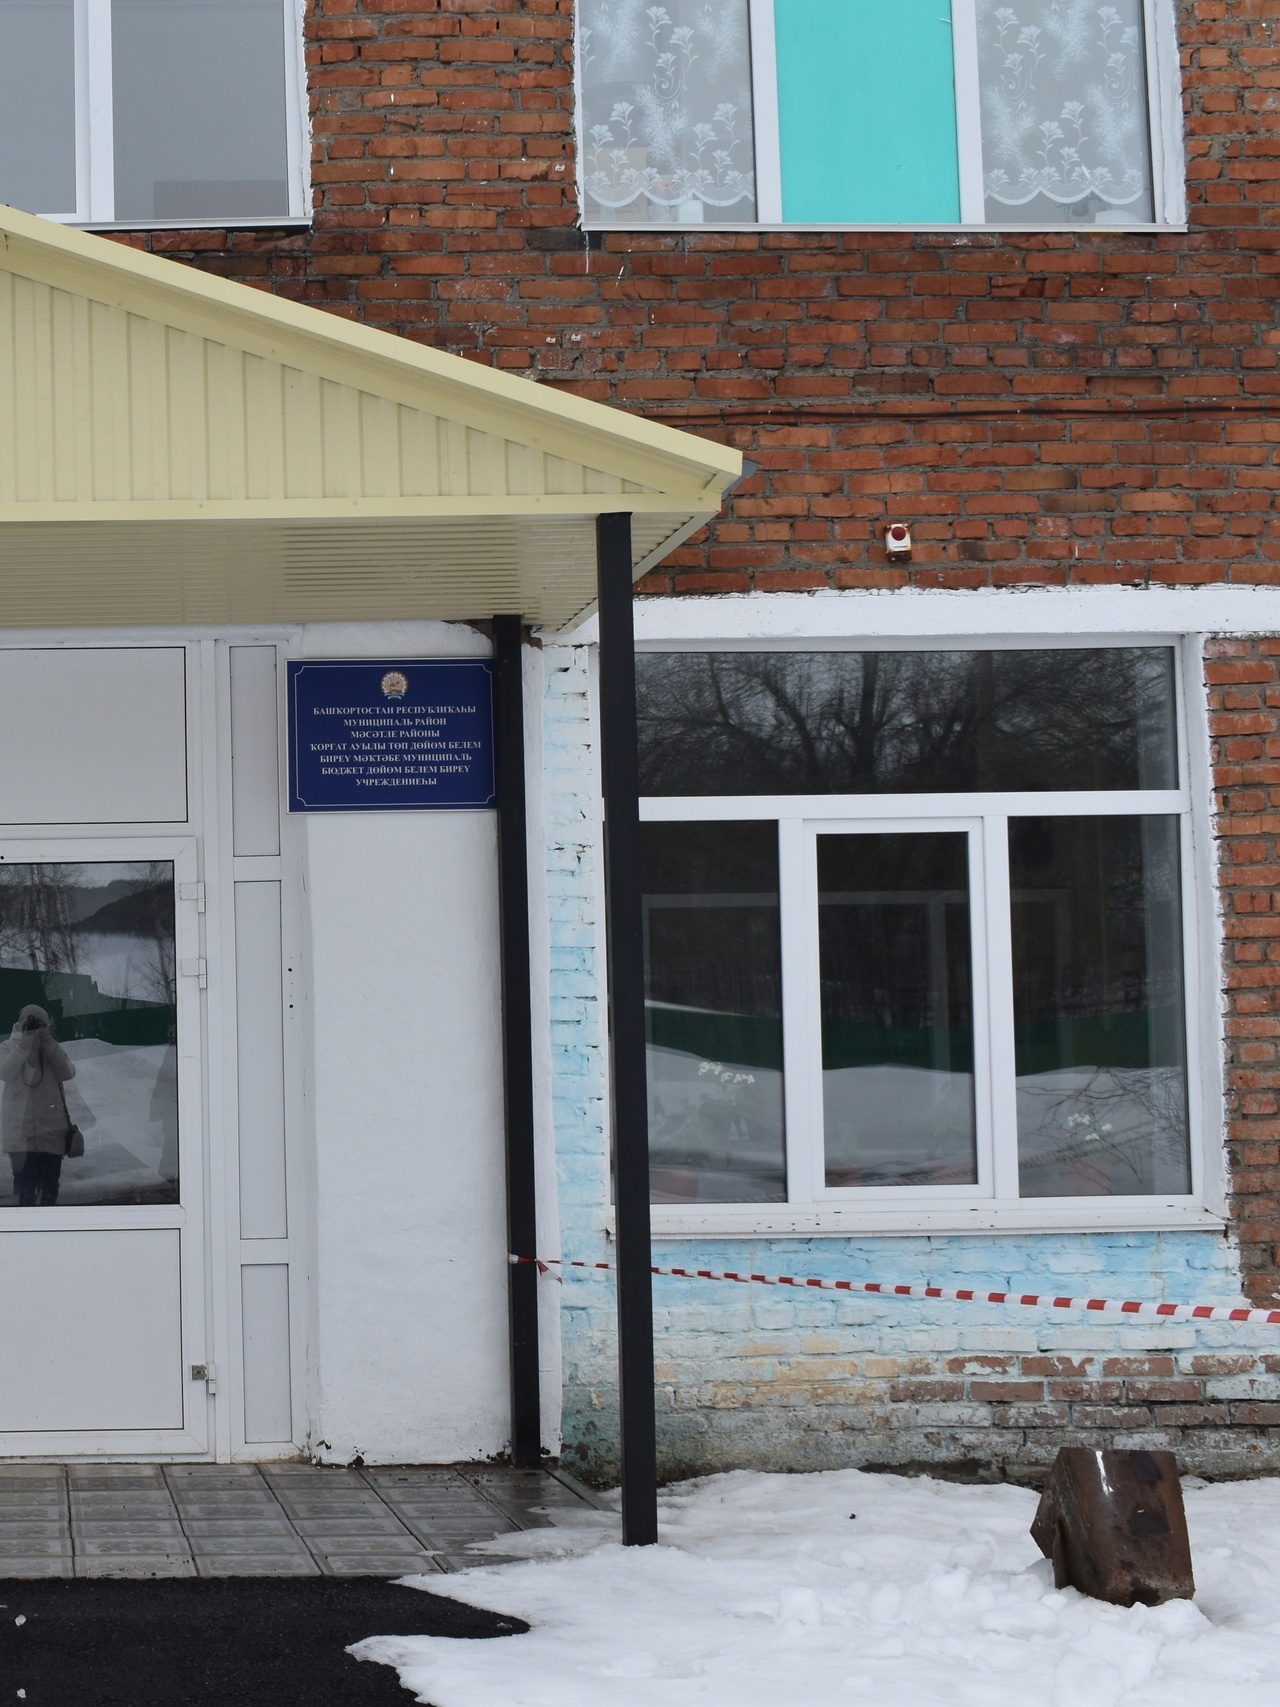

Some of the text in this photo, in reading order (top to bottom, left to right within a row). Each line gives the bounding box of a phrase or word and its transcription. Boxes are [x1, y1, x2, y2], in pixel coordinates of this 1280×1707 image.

[343, 717, 447, 727] МУНИЦИПАЛЬ РАЙОН
[399, 728, 440, 738] РАЙОНЫ
[349, 742, 386, 751] АУЫЛЫ
[448, 741, 481, 749] БЕЛЕМ
[402, 753, 472, 763] МУНИЦИПАЛЬ
[321, 767, 364, 776] БЮДЖЕТ
[404, 765, 438, 774] БЕЛЕМ
